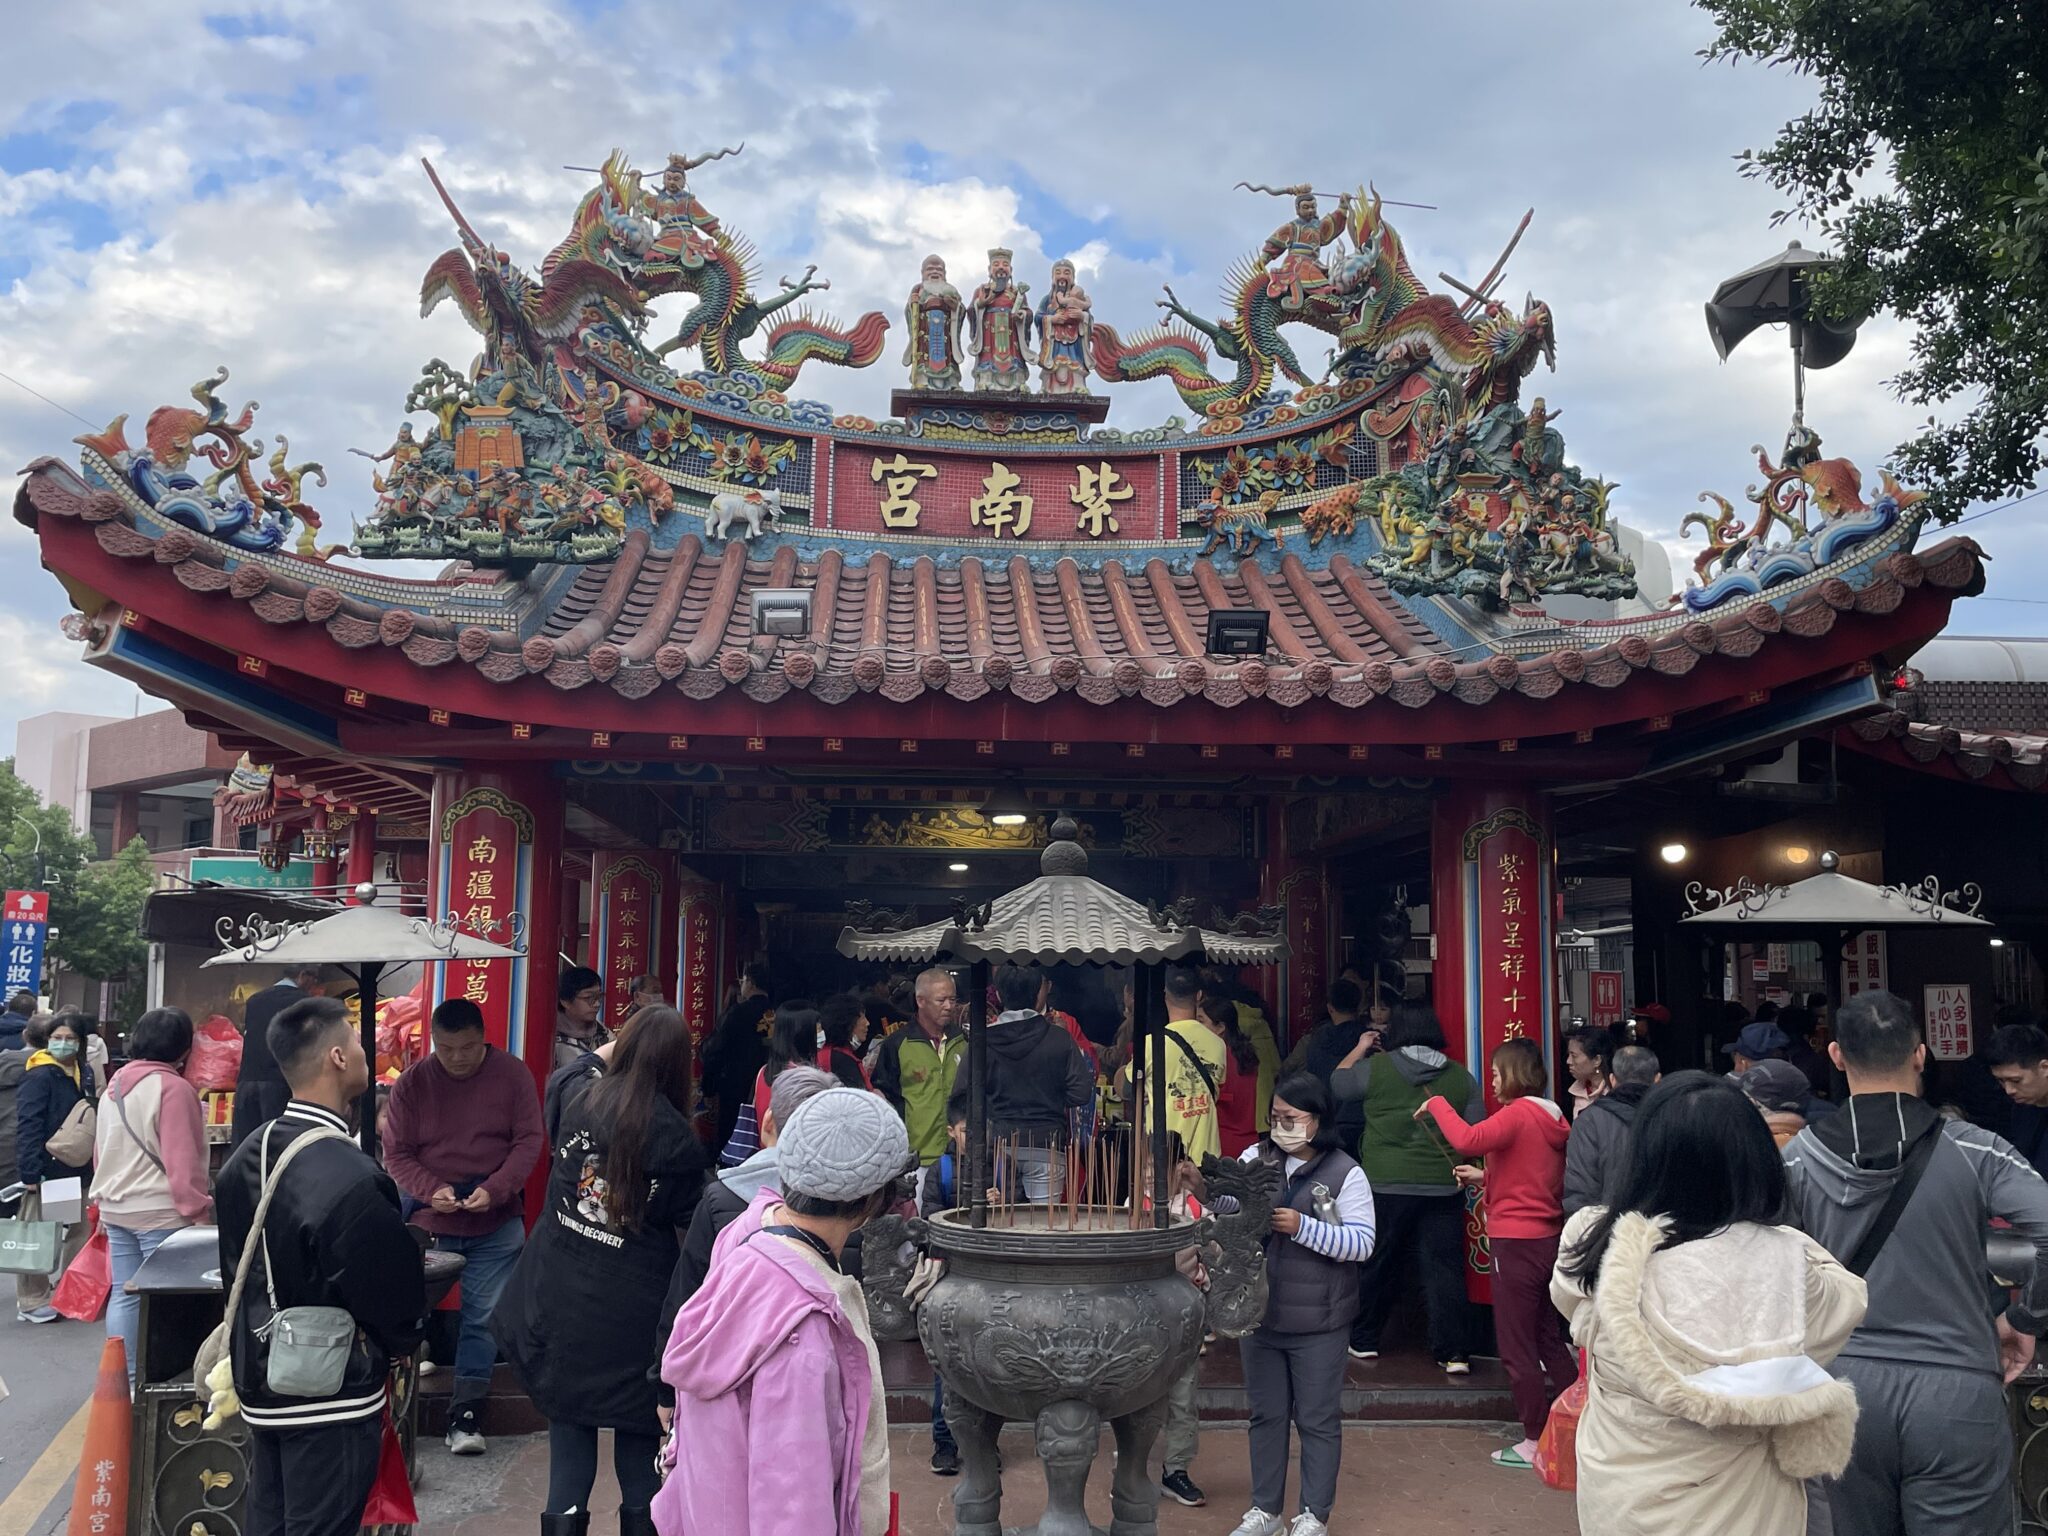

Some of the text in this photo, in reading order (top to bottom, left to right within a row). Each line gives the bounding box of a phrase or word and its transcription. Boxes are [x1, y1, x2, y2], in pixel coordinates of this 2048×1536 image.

[870, 453, 1134, 538] 紫南宮
[1938, 988, 1953, 1055] 小心扒手
[560, 1214, 584, 1234] THINGS
[582, 1225, 624, 1249] RECOVERY
[89, 1459, 115, 1533] 紫南宮
